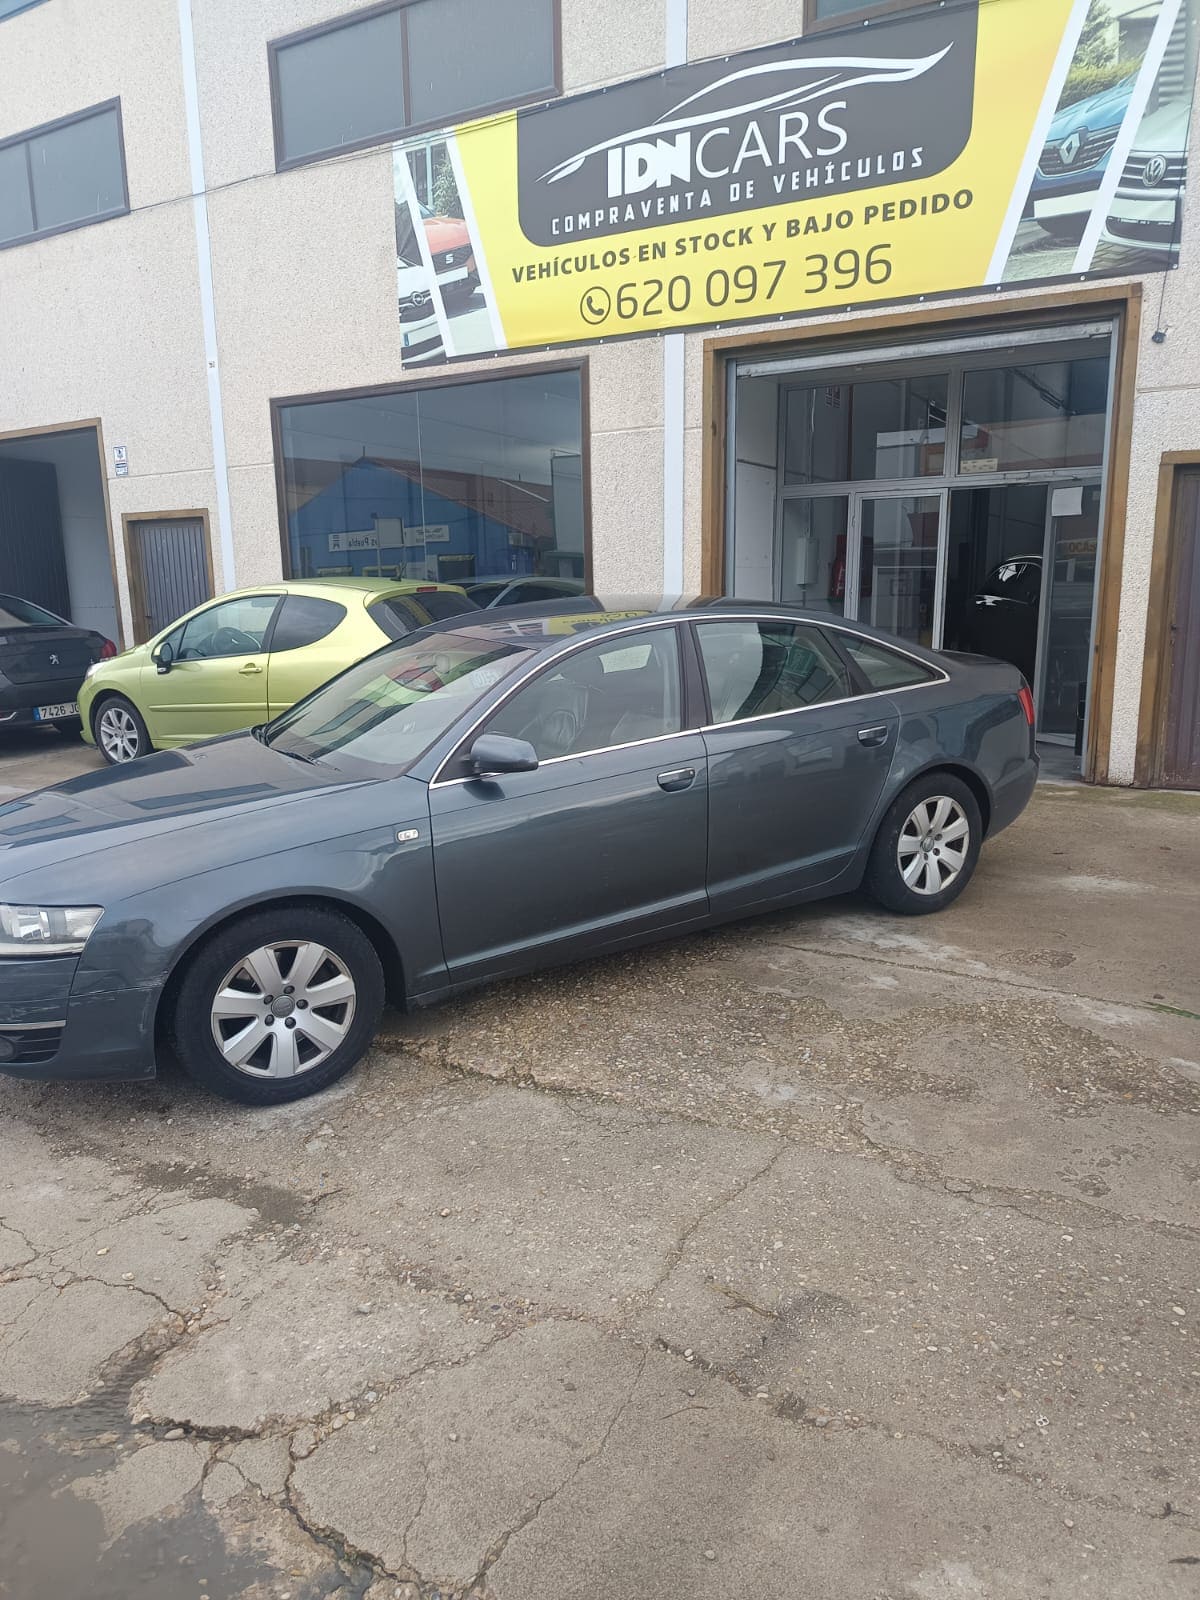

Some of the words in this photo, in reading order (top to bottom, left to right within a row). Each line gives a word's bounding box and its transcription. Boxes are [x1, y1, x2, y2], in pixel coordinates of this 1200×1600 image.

[551, 189, 712, 235] COMPRAVENTA
[729, 180, 754, 203] DE
[773, 146, 923, 194] VEHÍCULOS
[511, 247, 630, 284] VEHÍCULOS
[638, 241, 667, 263] EN
[675, 226, 754, 256] STOCK
[762, 222, 777, 242] Y
[786, 209, 854, 239] BAJO
[863, 188, 974, 226] PEDIDO
[616, 275, 692, 320] 620
[705, 259, 787, 307] 097
[804, 243, 893, 294] 396
[41, 704, 66, 719] 7426
